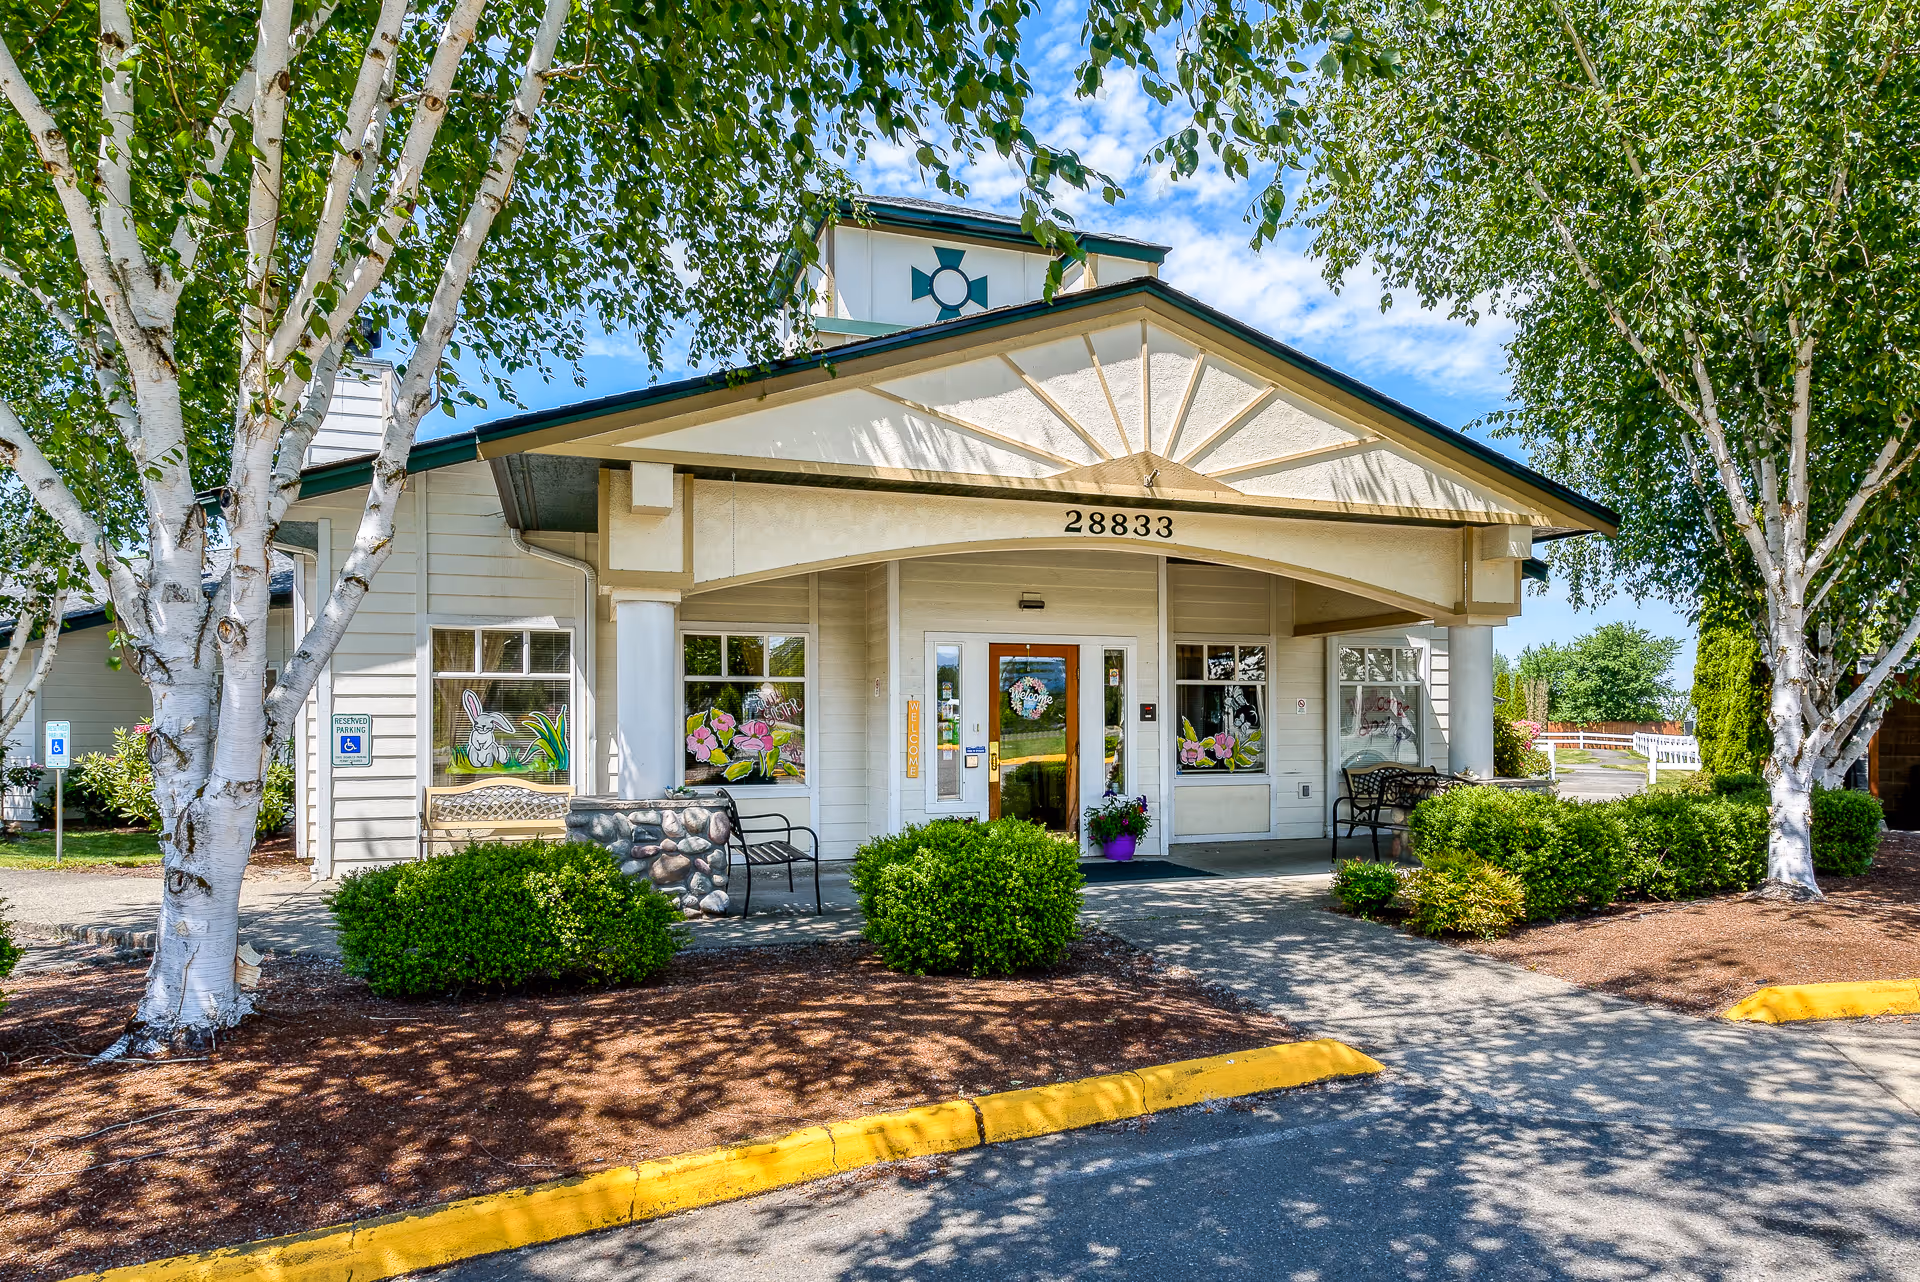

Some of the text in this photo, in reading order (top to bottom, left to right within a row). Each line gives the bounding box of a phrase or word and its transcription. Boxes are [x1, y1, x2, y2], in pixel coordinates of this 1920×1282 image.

[1064, 510, 1173, 538] 28833
[1009, 688, 1053, 704] Welcome
[334, 717, 368, 725] RESERVED
[336, 726, 366, 734] PARKING
[909, 702, 919, 776] WELCOME
